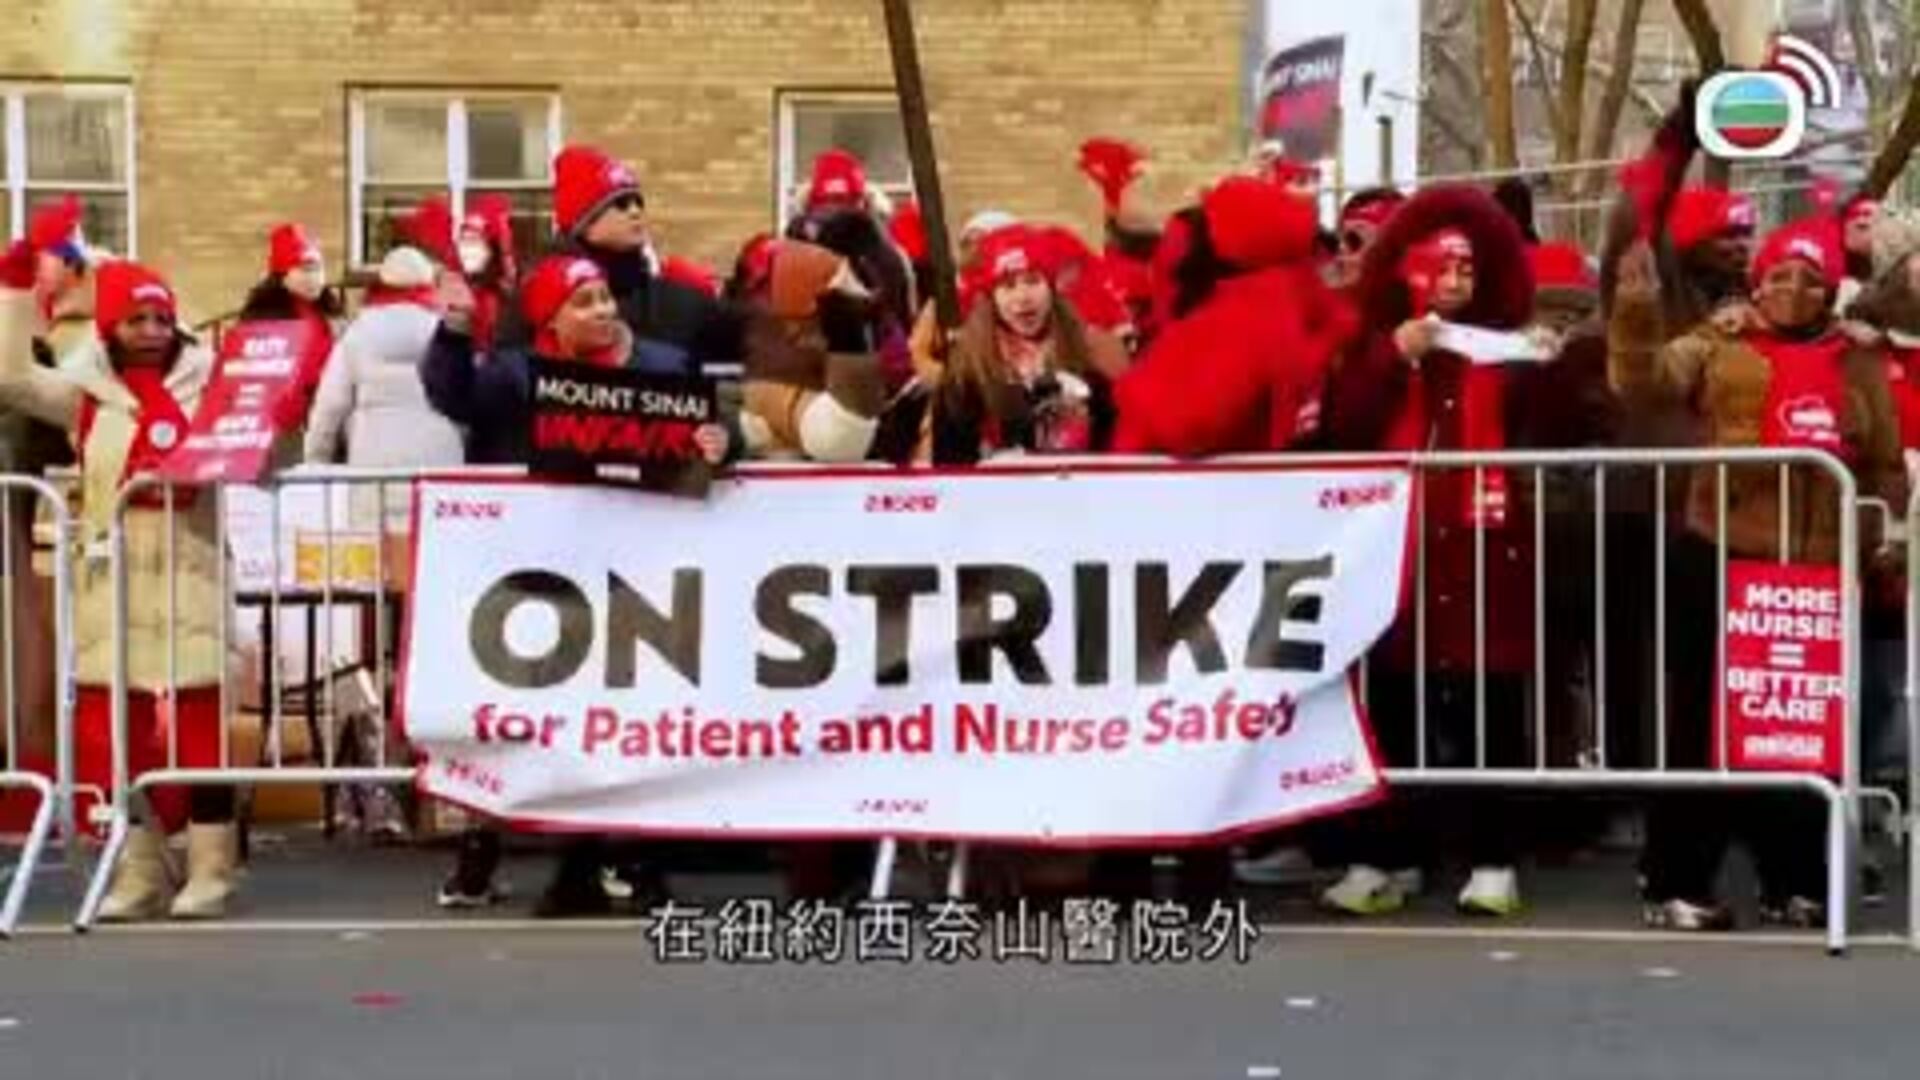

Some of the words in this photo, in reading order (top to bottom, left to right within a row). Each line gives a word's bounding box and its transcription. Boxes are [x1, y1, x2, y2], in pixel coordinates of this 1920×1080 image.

[536, 375, 634, 410] MOUNT
[639, 389, 709, 418] SINAI
[1746, 584, 1839, 614] MORE
[468, 566, 704, 690] ON
[755, 554, 1334, 690] STRIKE
[474, 701, 567, 747] for
[582, 706, 801, 758] Patient
[818, 703, 933, 754] and
[954, 703, 1130, 755] Nurse
[1740, 695, 1827, 722] CARE
